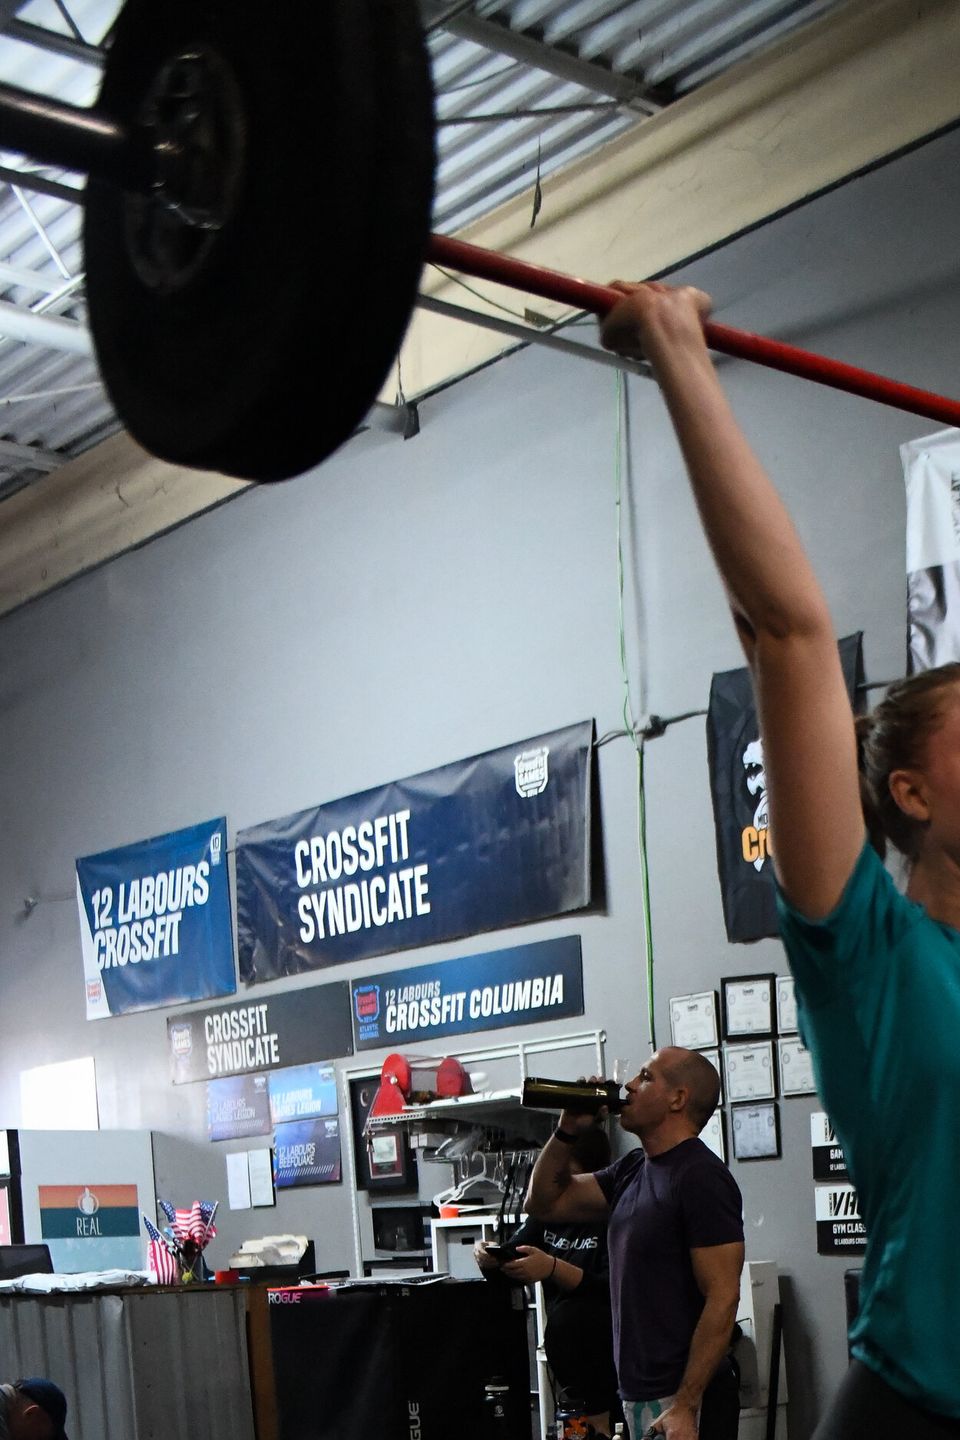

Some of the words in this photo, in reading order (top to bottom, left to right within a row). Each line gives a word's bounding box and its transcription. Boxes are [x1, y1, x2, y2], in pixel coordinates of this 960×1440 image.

[295, 809, 411, 888] CROSSFIT
[92, 887, 113, 929] 12
[118, 861, 209, 924] LABOURS
[298, 864, 431, 945] SYNDICATE
[94, 911, 182, 970] CROSSFIT
[385, 989, 396, 1007] 12
[399, 980, 441, 1003] LABOURS
[386, 992, 466, 1033] CROSSFIT
[469, 974, 564, 1019] COLUMBIA
[205, 1004, 268, 1044] CROSSFIT
[207, 1033, 279, 1074] SYNDICATE
[287, 1142, 316, 1157] LABOURS
[76, 1217, 102, 1236] REAL
[833, 1223, 846, 1235] GYM
[267, 1292, 303, 1304] ROGUE
